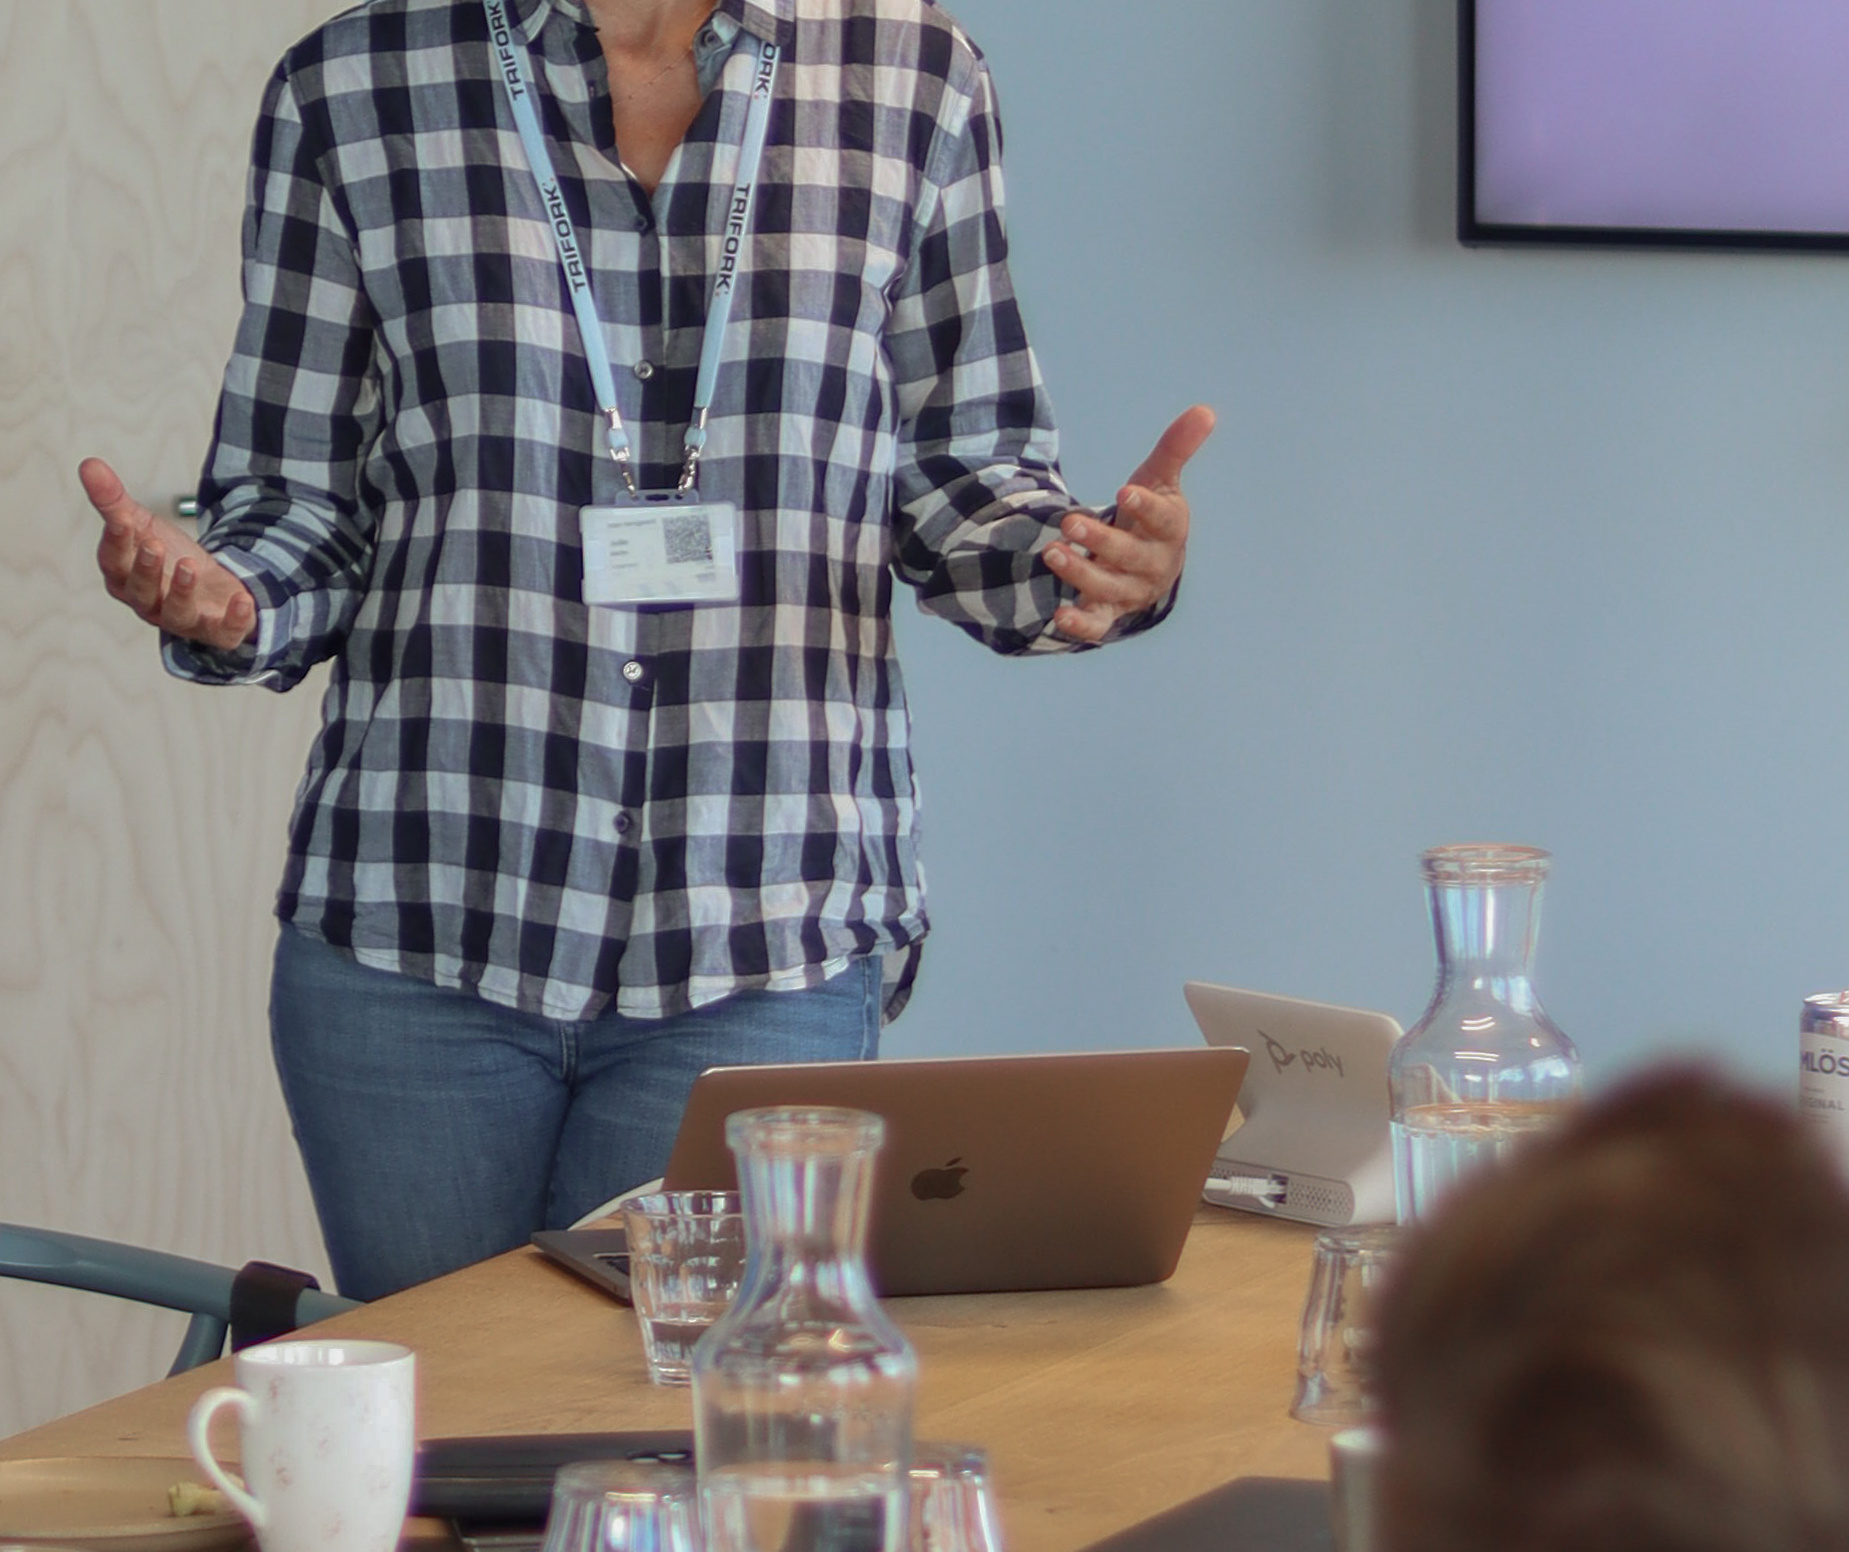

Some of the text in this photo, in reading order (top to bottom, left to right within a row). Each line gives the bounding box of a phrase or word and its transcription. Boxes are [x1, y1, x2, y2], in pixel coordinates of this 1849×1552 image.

[489, 1, 525, 101] TRIFORK
[543, 184, 586, 294] TRIFORK
[716, 184, 749, 293] TRIFORK
[1300, 1047, 1345, 1078] poly
